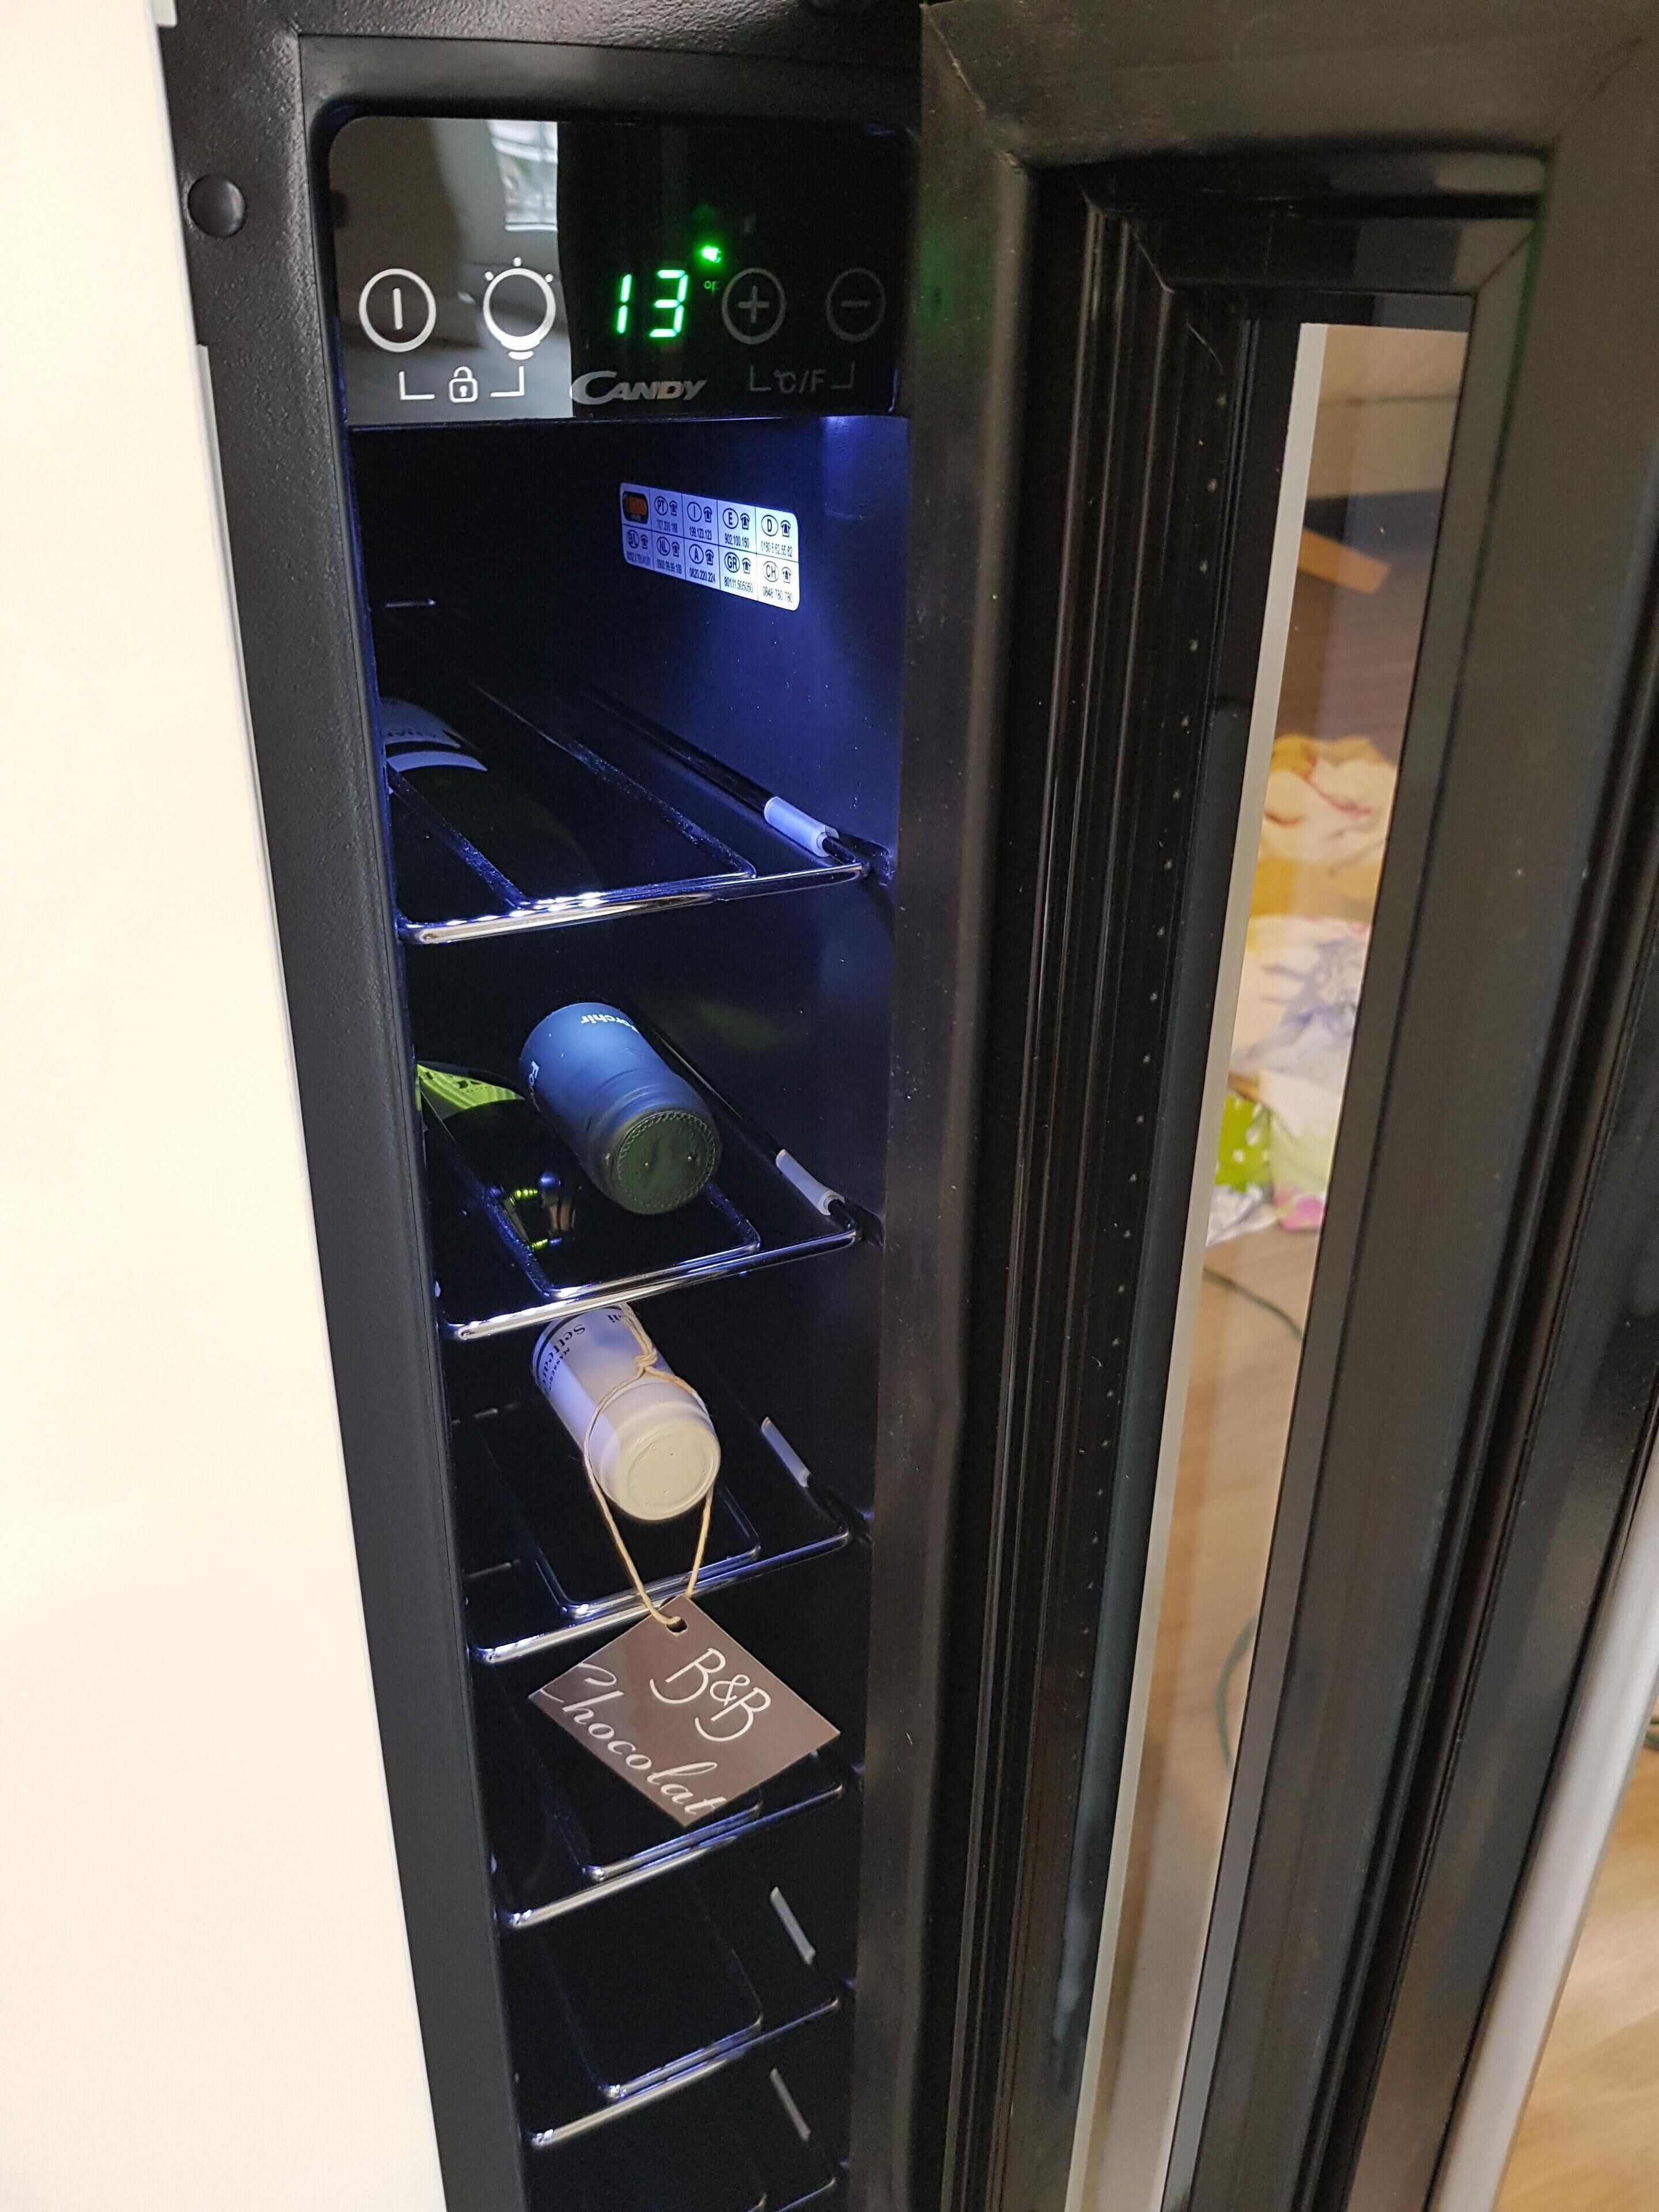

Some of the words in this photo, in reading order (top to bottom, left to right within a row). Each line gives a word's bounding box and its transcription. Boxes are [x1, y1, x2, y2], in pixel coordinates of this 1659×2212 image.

[616, 268, 689, 338] 13
[569, 370, 708, 406] CANDY
[728, 511, 733, 525] E
[767, 518, 772, 532] D
[694, 547, 699, 561] A
[727, 555, 737, 570] GR
[766, 564, 777, 579] CH
[649, 1647, 771, 1742] B&B
